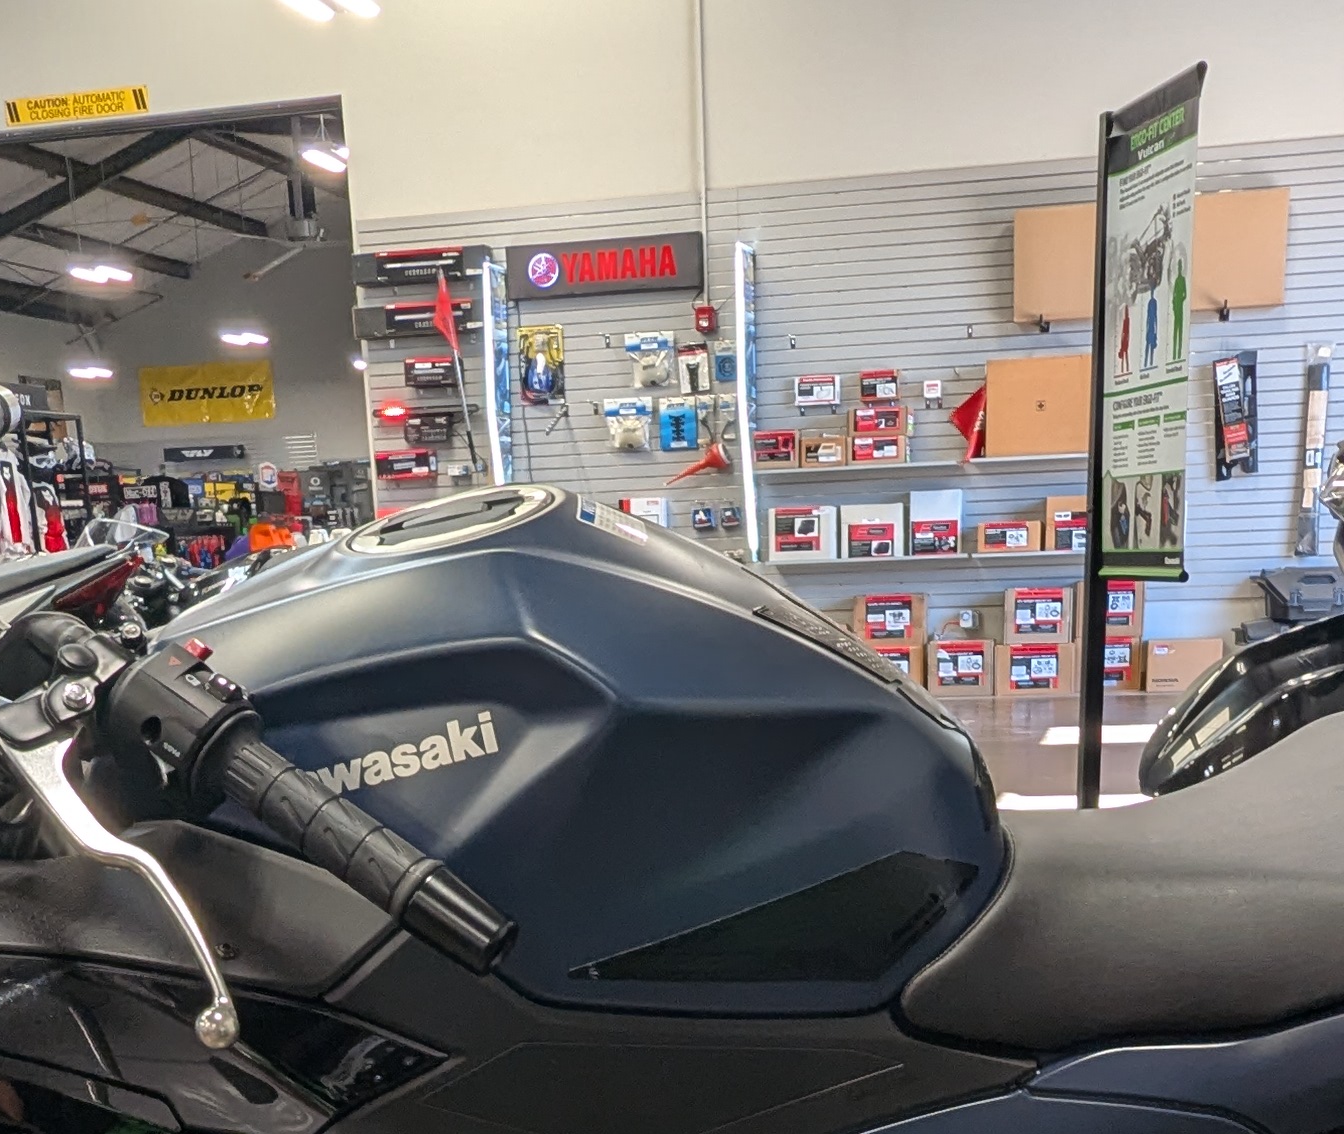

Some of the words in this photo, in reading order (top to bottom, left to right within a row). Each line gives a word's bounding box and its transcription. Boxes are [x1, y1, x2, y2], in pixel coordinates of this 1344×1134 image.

[72, 91, 126, 106] AUTOMATIC
[30, 107, 71, 121] CLOSING
[73, 105, 94, 116] FIRE
[96, 102, 124, 114] DOOR
[1137, 139, 1165, 160] Vulcan
[562, 244, 677, 284] YAMAHA
[167, 383, 264, 403] DUNLOP
[296, 710, 499, 795] wasaki
